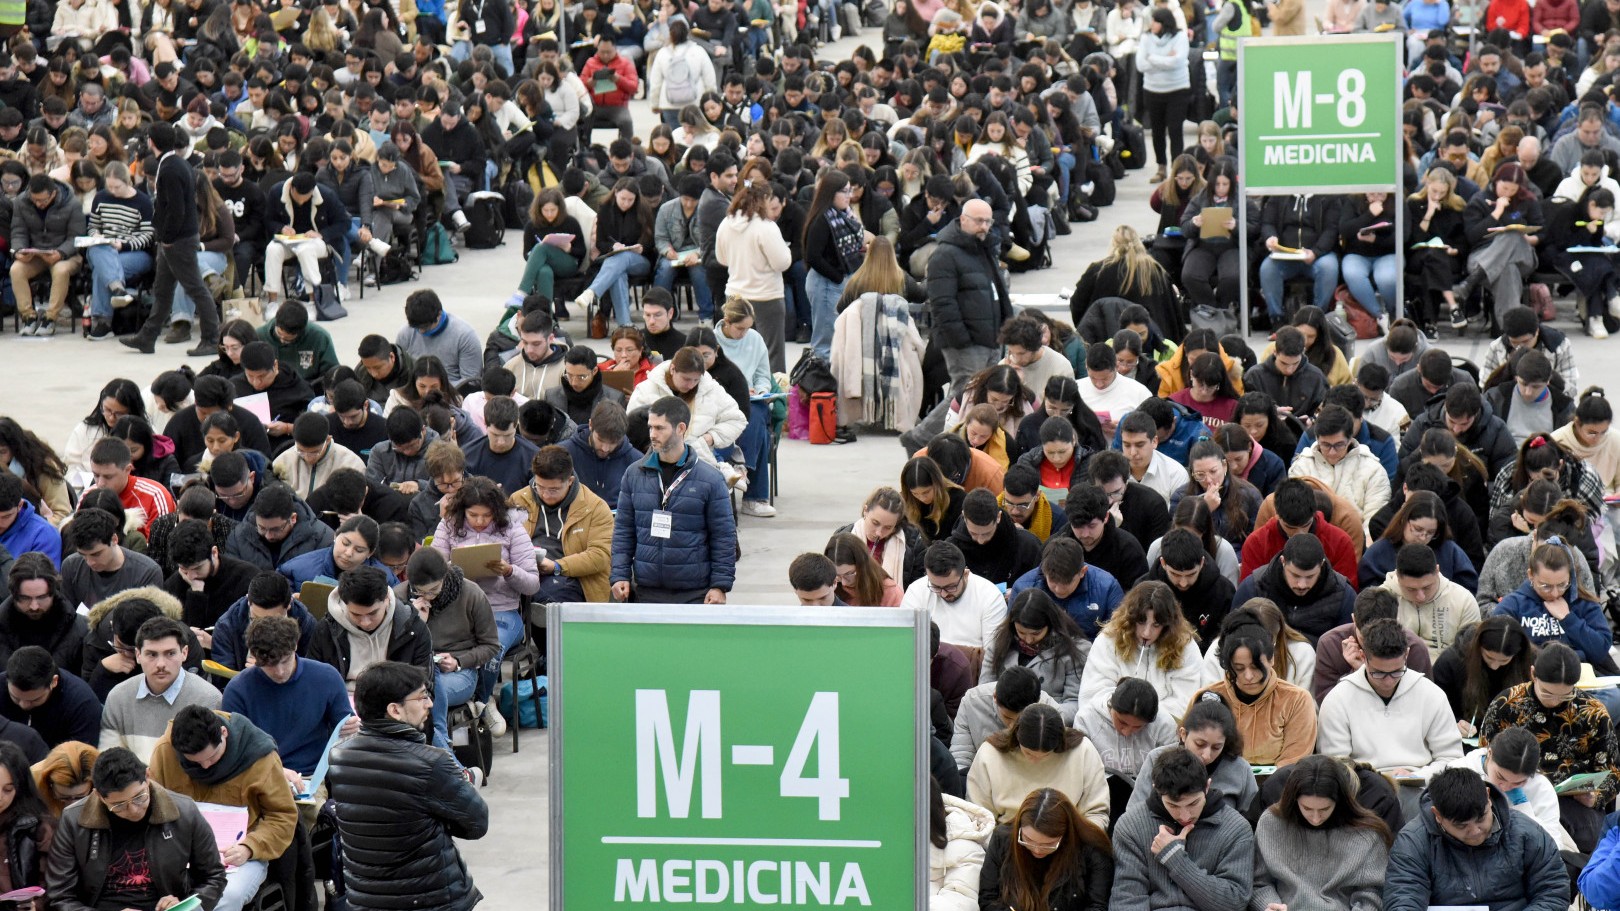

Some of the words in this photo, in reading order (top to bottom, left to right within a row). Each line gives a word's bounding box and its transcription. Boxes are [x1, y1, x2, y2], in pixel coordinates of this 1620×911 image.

[1274, 68, 1366, 128] M-8
[1264, 142, 1377, 165] MEDICINA
[635, 689, 850, 821] M-4
[614, 858, 873, 906] MEDICINA
